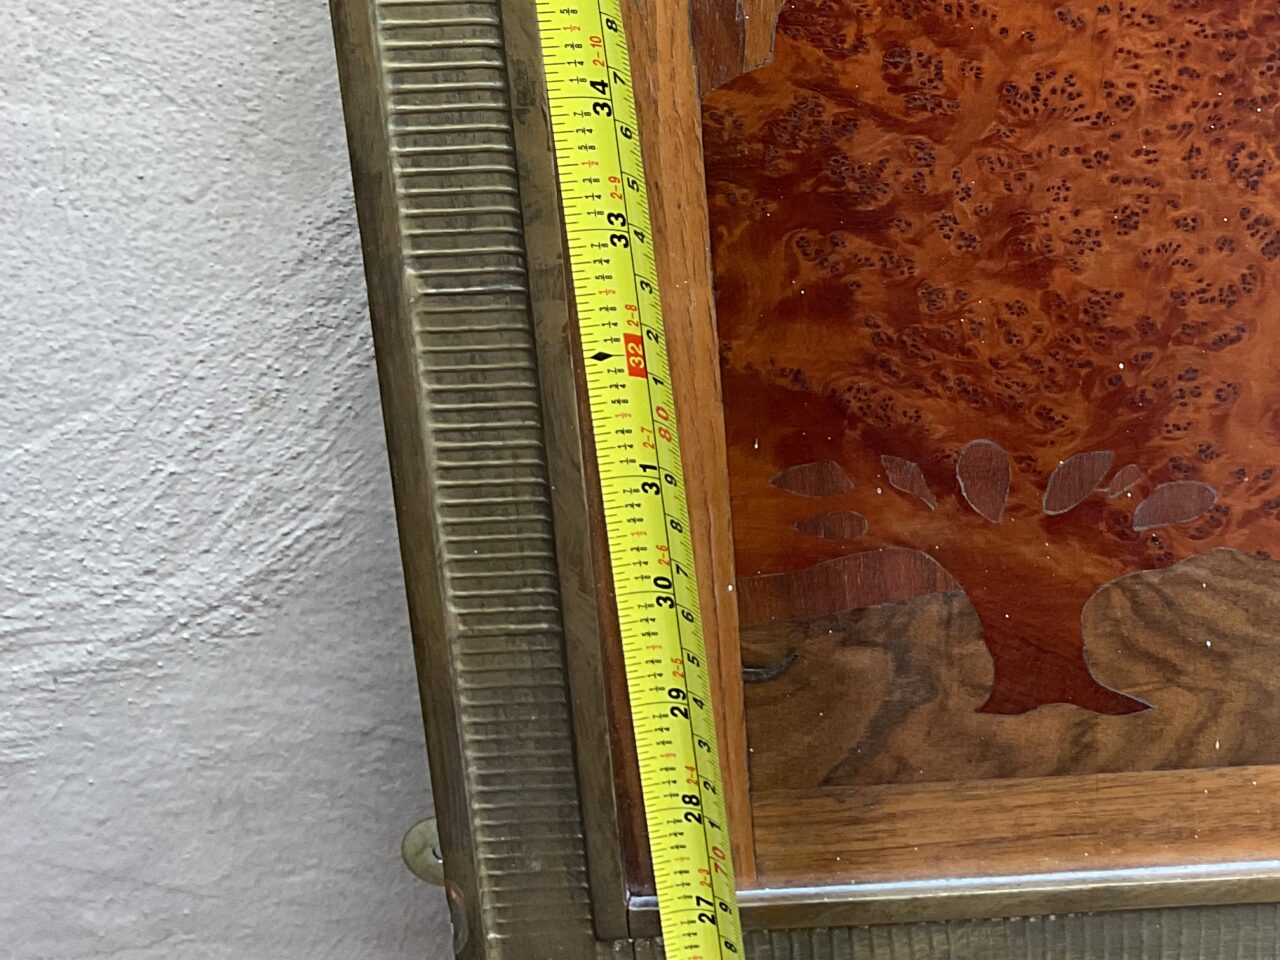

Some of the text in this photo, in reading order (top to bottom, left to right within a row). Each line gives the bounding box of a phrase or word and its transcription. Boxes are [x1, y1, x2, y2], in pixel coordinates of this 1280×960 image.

[606, 17, 618, 32] 8
[613, 72, 625, 85] 7
[590, 80, 611, 117] 34
[620, 126, 632, 140] 6
[627, 177, 640, 192] 5
[607, 213, 628, 248] 33
[633, 229, 645, 243] 4
[640, 280, 653, 294] 3
[646, 330, 658, 344] 2
[627, 342, 644, 369] 32
[653, 376, 664, 386] 1
[640, 464, 660, 495] 31
[665, 474, 677, 487] 9
[671, 519, 683, 533] 8
[676, 564, 689, 577] 7
[654, 576, 674, 609] 30
[681, 609, 694, 623] 6
[687, 654, 700, 667] 5
[668, 688, 689, 719] 29
[692, 698, 704, 710] 4
[698, 740, 711, 753] 3
[703, 781, 716, 794] 2
[682, 795, 702, 824] 28
[708, 820, 721, 831] 1
[696, 896, 716, 925] 27
[719, 902, 732, 914] 9
[724, 940, 737, 953] 8
